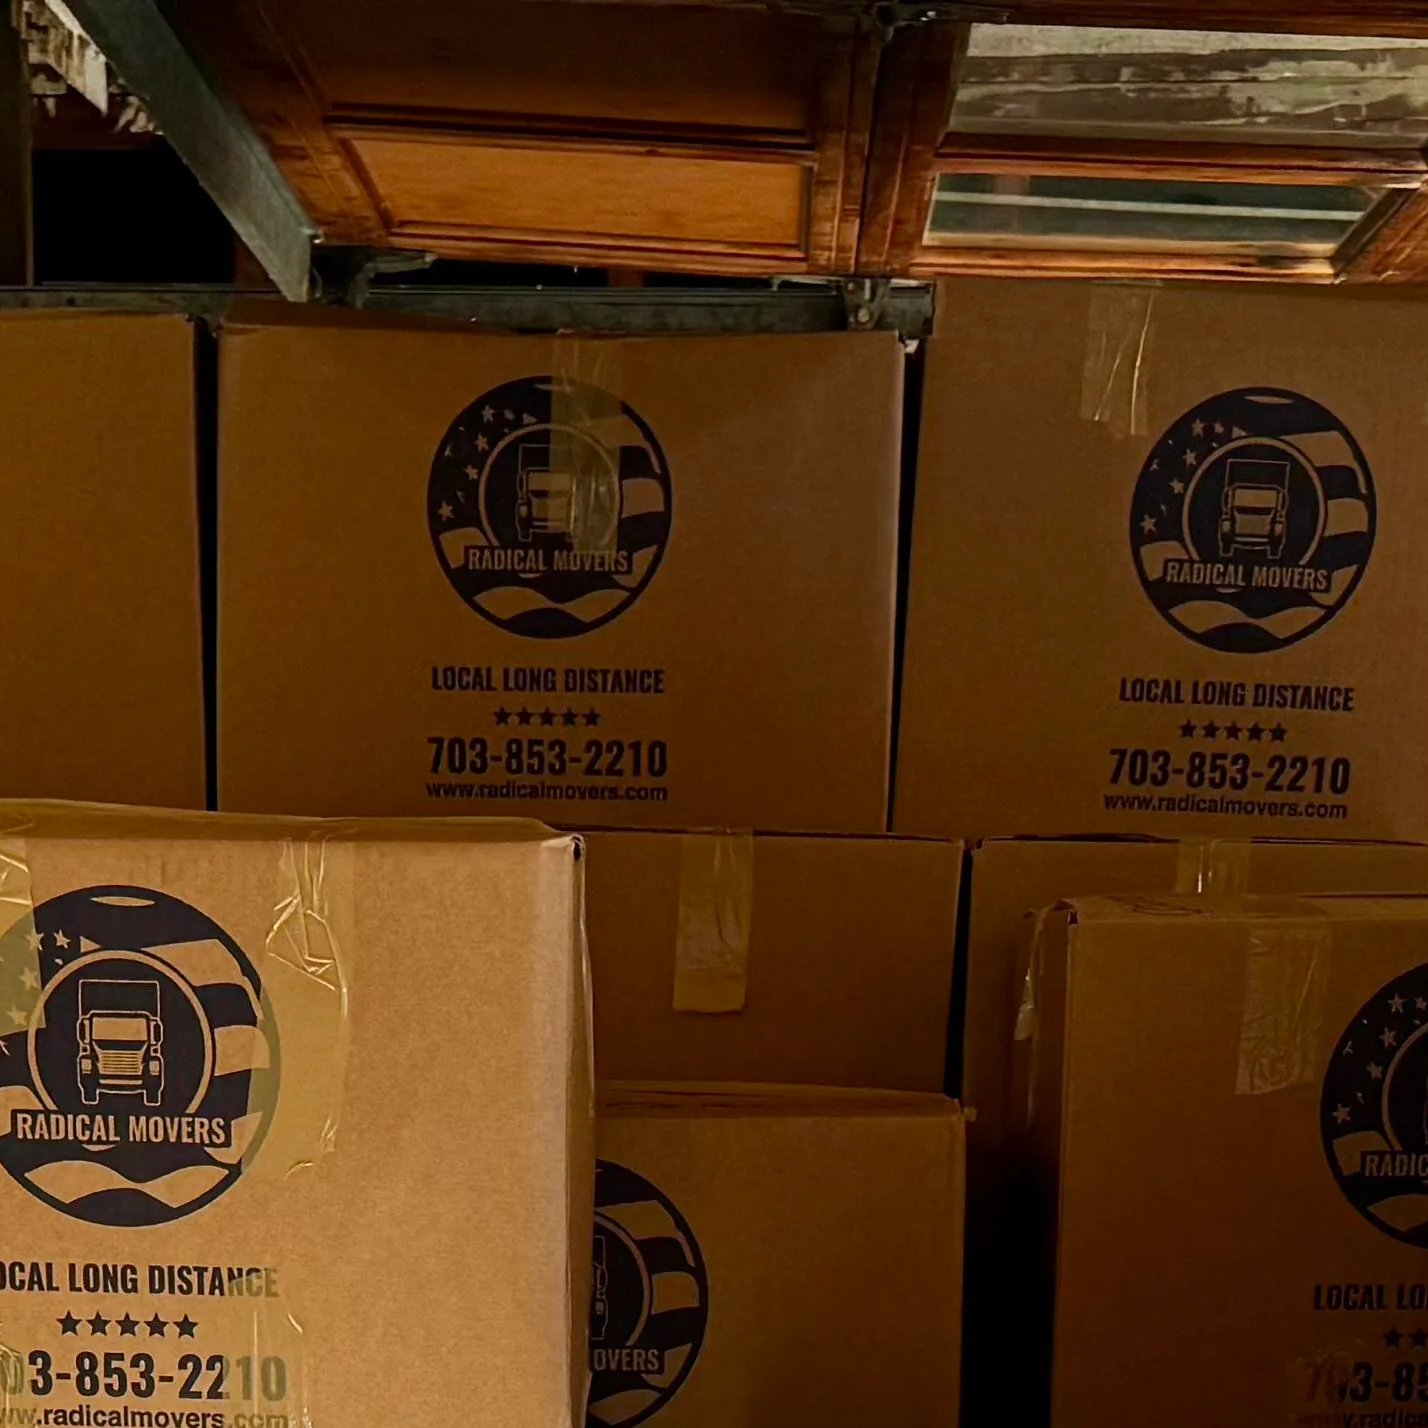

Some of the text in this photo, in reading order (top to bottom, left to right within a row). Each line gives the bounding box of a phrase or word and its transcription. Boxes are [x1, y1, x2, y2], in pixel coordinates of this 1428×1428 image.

[468, 548, 629, 572] RADICAL MOVERS
[1166, 561, 1329, 590] RADICAL MOVERS
[431, 667, 664, 693] LOCAL LONG DISTANCE
[1119, 677, 1355, 711] LOCAL LONG DISTANCE
[427, 737, 667, 777] 703-853-2210
[1109, 748, 1350, 795] 703-853-2210
[426, 781, 667, 801] www.radicalmovers.com
[1104, 793, 1347, 819] www.radicalmovers.com
[16, 1112, 226, 1144] RADICAL MOVERS
[68, 1263, 138, 1294] LONG
[148, 1264, 279, 1298] DISTANCE
[1314, 1284, 1388, 1311] LOCAL
[591, 1348, 660, 1372] OVERS
